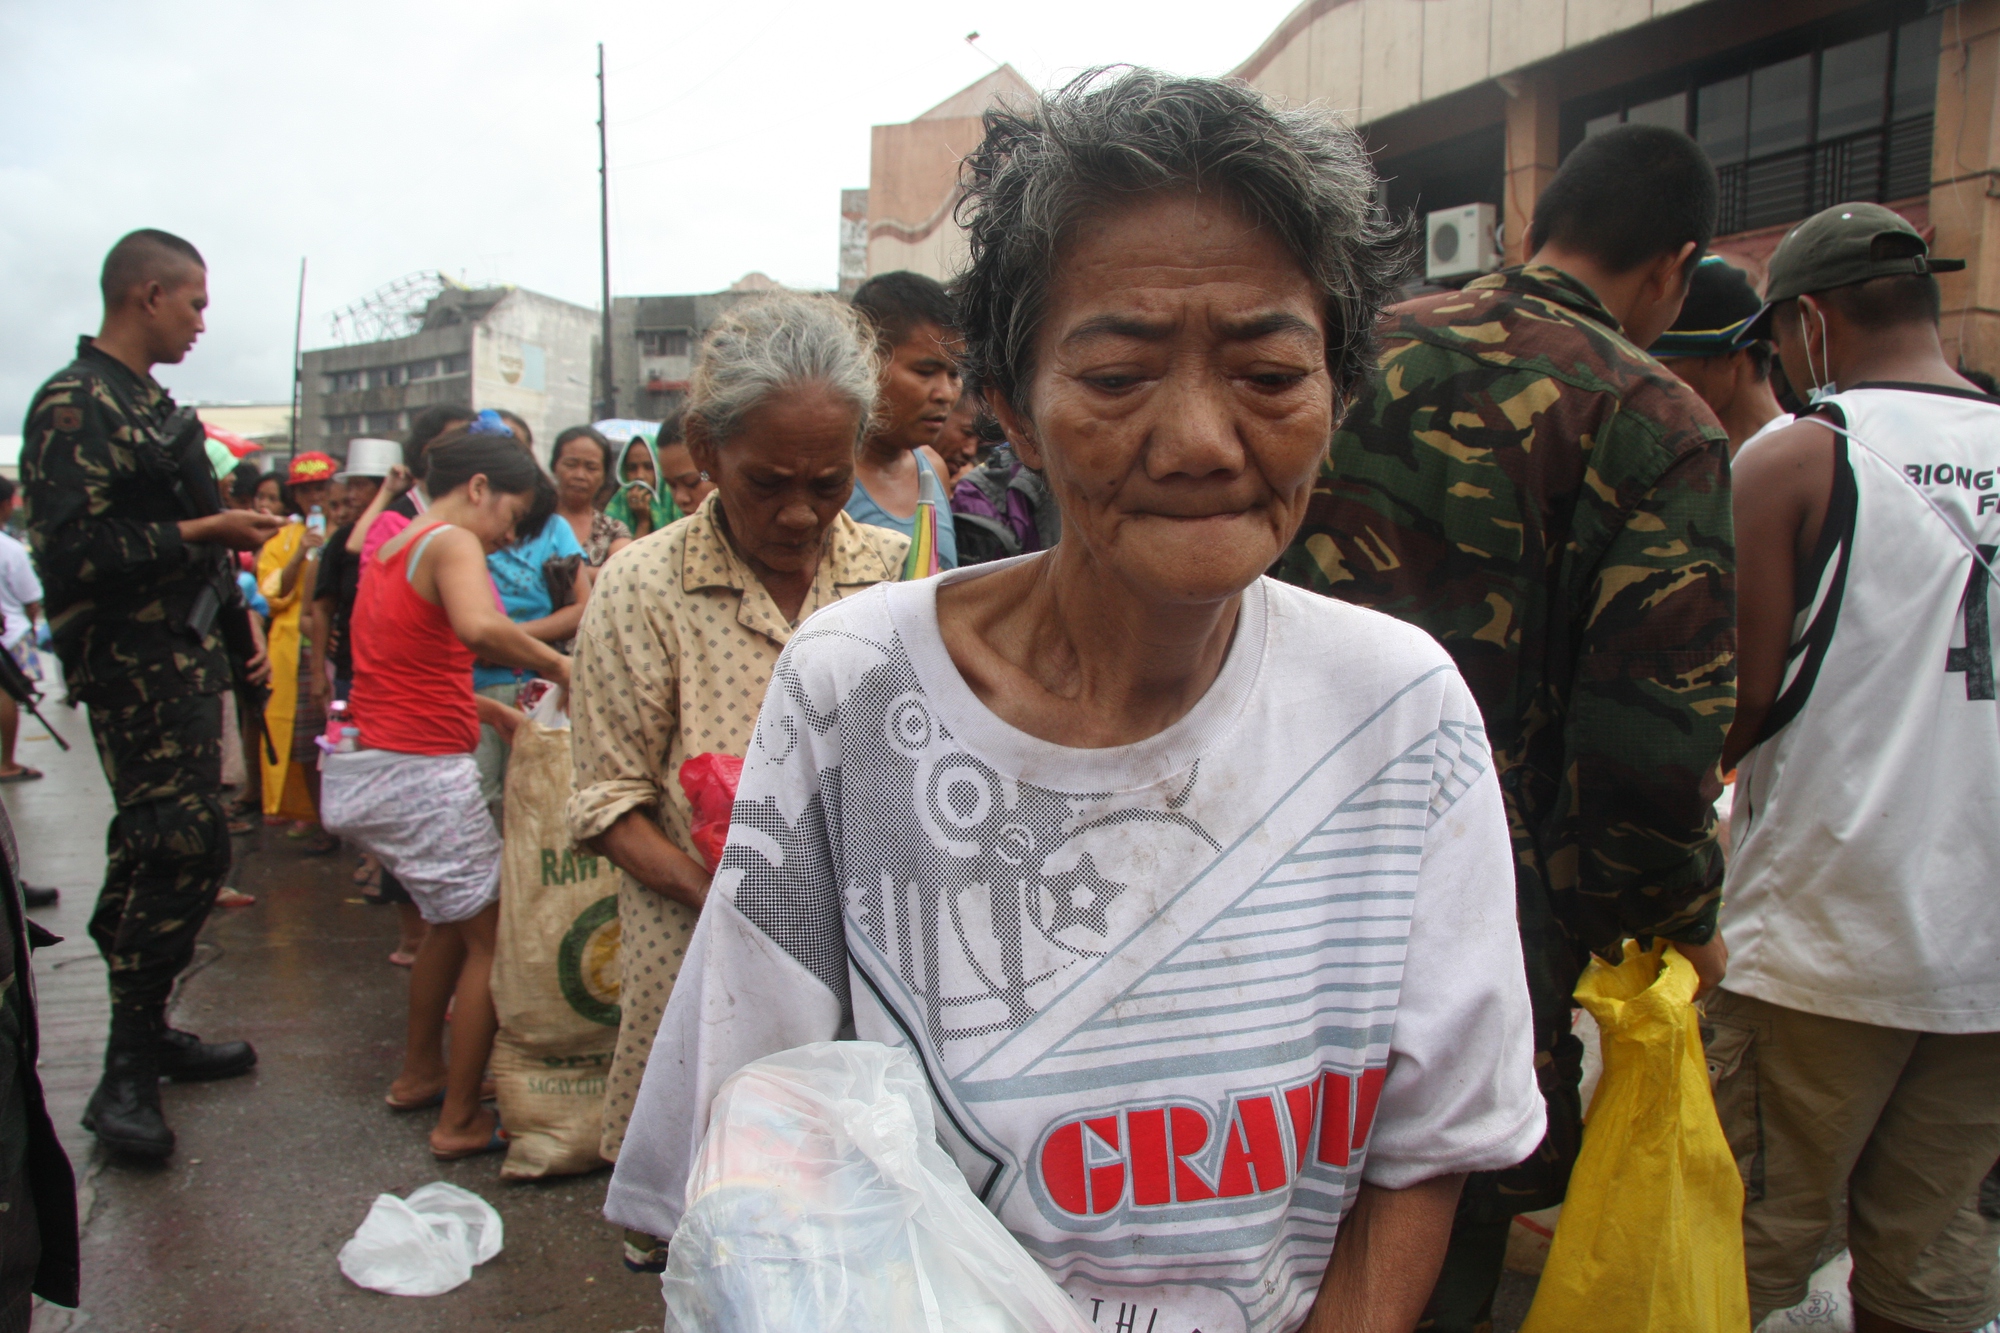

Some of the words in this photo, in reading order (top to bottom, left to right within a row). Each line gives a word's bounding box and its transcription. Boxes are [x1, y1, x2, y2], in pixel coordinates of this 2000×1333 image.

[1903, 463, 1994, 491] BIONG
[1976, 493, 2000, 516] F
[541, 848, 598, 886] RAW
